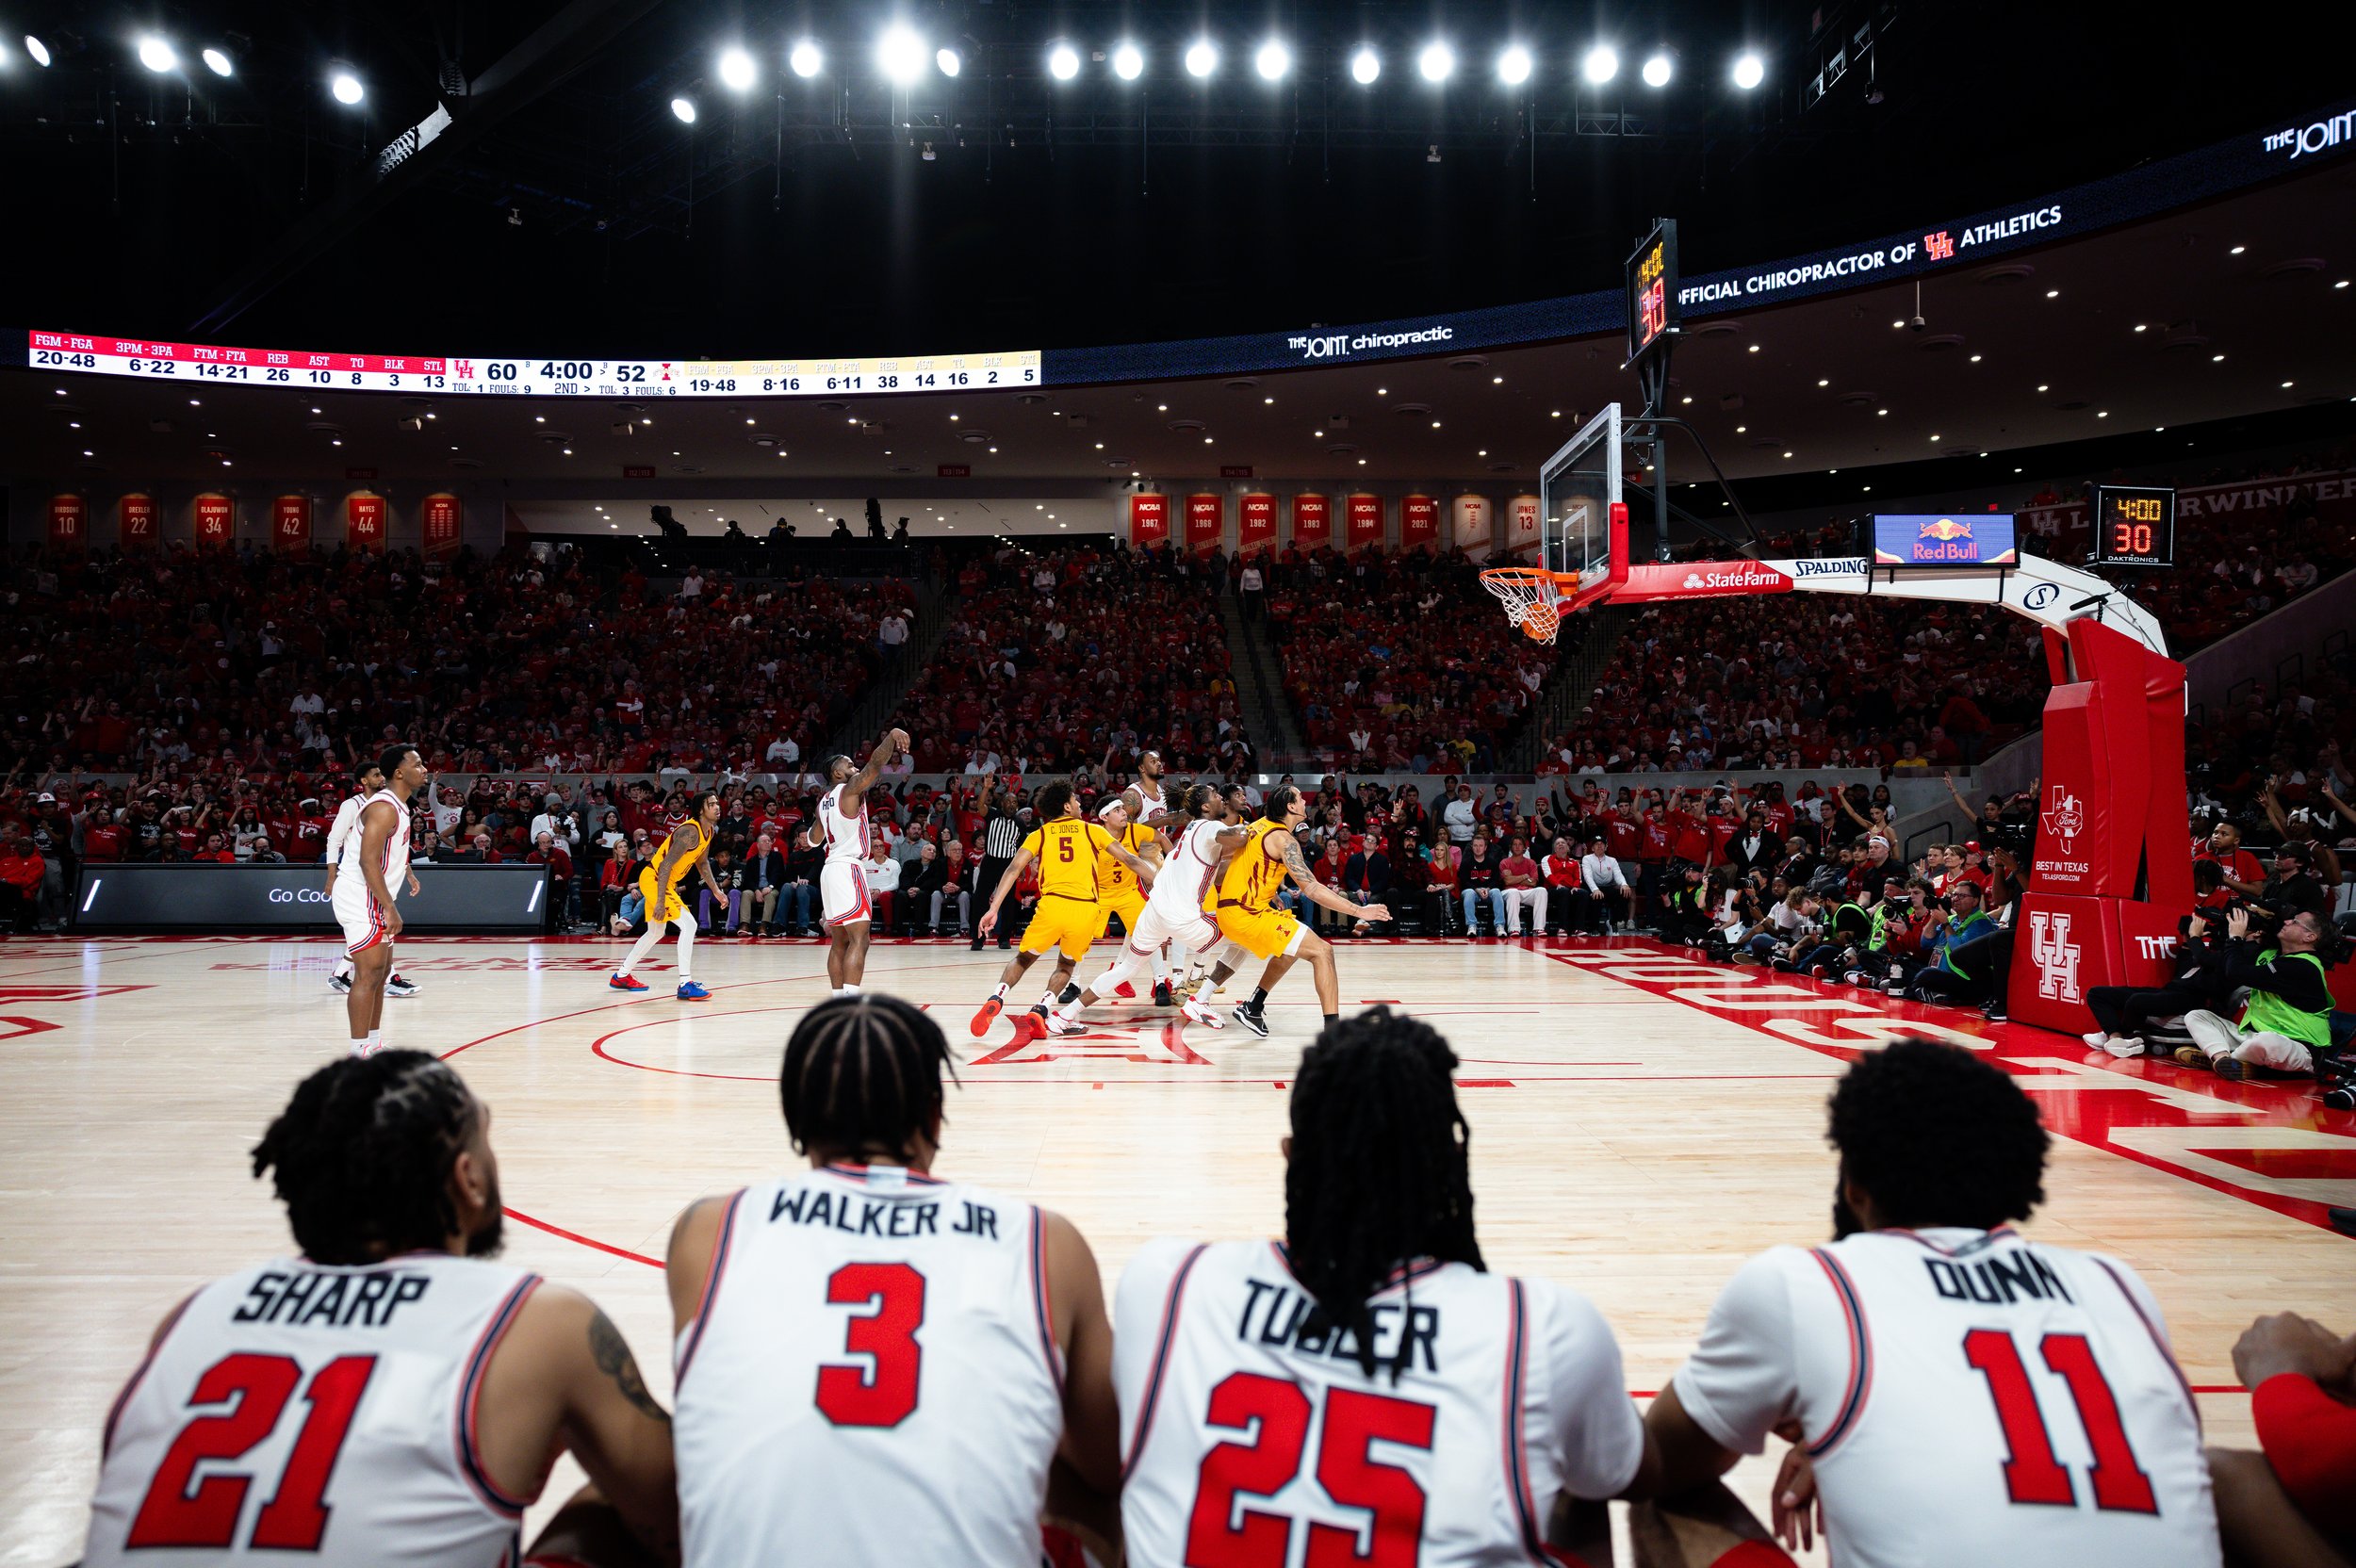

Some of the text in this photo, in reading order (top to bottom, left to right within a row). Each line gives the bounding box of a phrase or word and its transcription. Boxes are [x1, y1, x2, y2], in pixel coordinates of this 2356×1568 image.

[2262, 109, 2356, 159] THE JOIN
[1678, 281, 1741, 305] FFICIAL
[1746, 251, 1885, 294] CHIROPRACTOR
[1890, 243, 1916, 263] OF
[1961, 205, 2062, 247] ATHLETICS
[35, 334, 61, 347] FGM
[70, 337, 94, 351] FGA
[1288, 337, 1306, 349] THE
[1352, 326, 1452, 349] chiropractic
[116, 342, 142, 354] 3PM
[151, 345, 173, 356] 3PA
[193, 349, 218, 360] FTM
[225, 351, 247, 362] FTA
[37, 351, 95, 368] 20-48
[268, 352, 288, 364] REB
[309, 356, 330, 366] AST
[351, 358, 364, 368] TO
[384, 360, 405, 369] BLK
[129, 358, 175, 374] 6-22
[195, 364, 248, 379] 14-21
[424, 361, 443, 371] STL
[487, 364, 517, 380] 60
[540, 362, 593, 379] 4:00
[266, 368, 290, 382] 26
[309, 371, 331, 384] 10
[352, 373, 362, 385] 8
[389, 374, 400, 386] 3
[423, 375, 445, 388] 13
[616, 366, 646, 383] 52
[877, 375, 899, 388] 38
[915, 374, 936, 386] 14
[948, 372, 969, 385] 16
[988, 371, 998, 384] 2
[1023, 369, 1035, 382] 5
[452, 383, 532, 394] TOL: 1 FOULS: 9
[554, 383, 579, 394] 2ND
[599, 384, 677, 396] TOL: 3 FOULS: 6
[690, 379, 737, 392] 19-48
[762, 378, 800, 392] 8-16
[826, 377, 861, 390] 6-11
[1138, 503, 1161, 512] NCAA
[1248, 503, 1269, 512] NCAA
[1301, 503, 1323, 512] NCAA
[1515, 505, 1536, 514] JONES
[2118, 499, 2161, 521] 4:00
[58, 516, 75, 533] 10
[131, 516, 147, 533] 22
[205, 516, 222, 533] 34
[283, 517, 300, 535] 42
[358, 516, 375, 533] 44
[1519, 516, 1533, 530] 13
[2114, 524, 2151, 554] 30
[1913, 543, 1978, 560] Red Bull
[2107, 555, 2160, 564] DAKTRONICS
[1796, 558, 1868, 577] SPALDING
[822, 797, 835, 810] HD
[2059, 812, 2078, 825] Ford
[1050, 825, 1080, 835] C. JONES
[1059, 837, 1074, 863] 5
[2036, 861, 2088, 873] BEST IN TEXAS
[1112, 871, 1122, 884] 3
[2041, 873, 2081, 882] TEXASFORD.COM
[269, 889, 293, 903] Go
[2135, 936, 2177, 959] THE
[2030, 910, 2081, 1004] UH
[769, 1188, 999, 1240] WALKER JR
[1922, 1249, 2073, 1304] DUNN
[232, 1271, 430, 1327] SHARP
[814, 1261, 925, 1429] 3
[1962, 1327, 2162, 1517] 11
[124, 1351, 379, 1551] 21
[1184, 1370, 1438, 1568] 25
